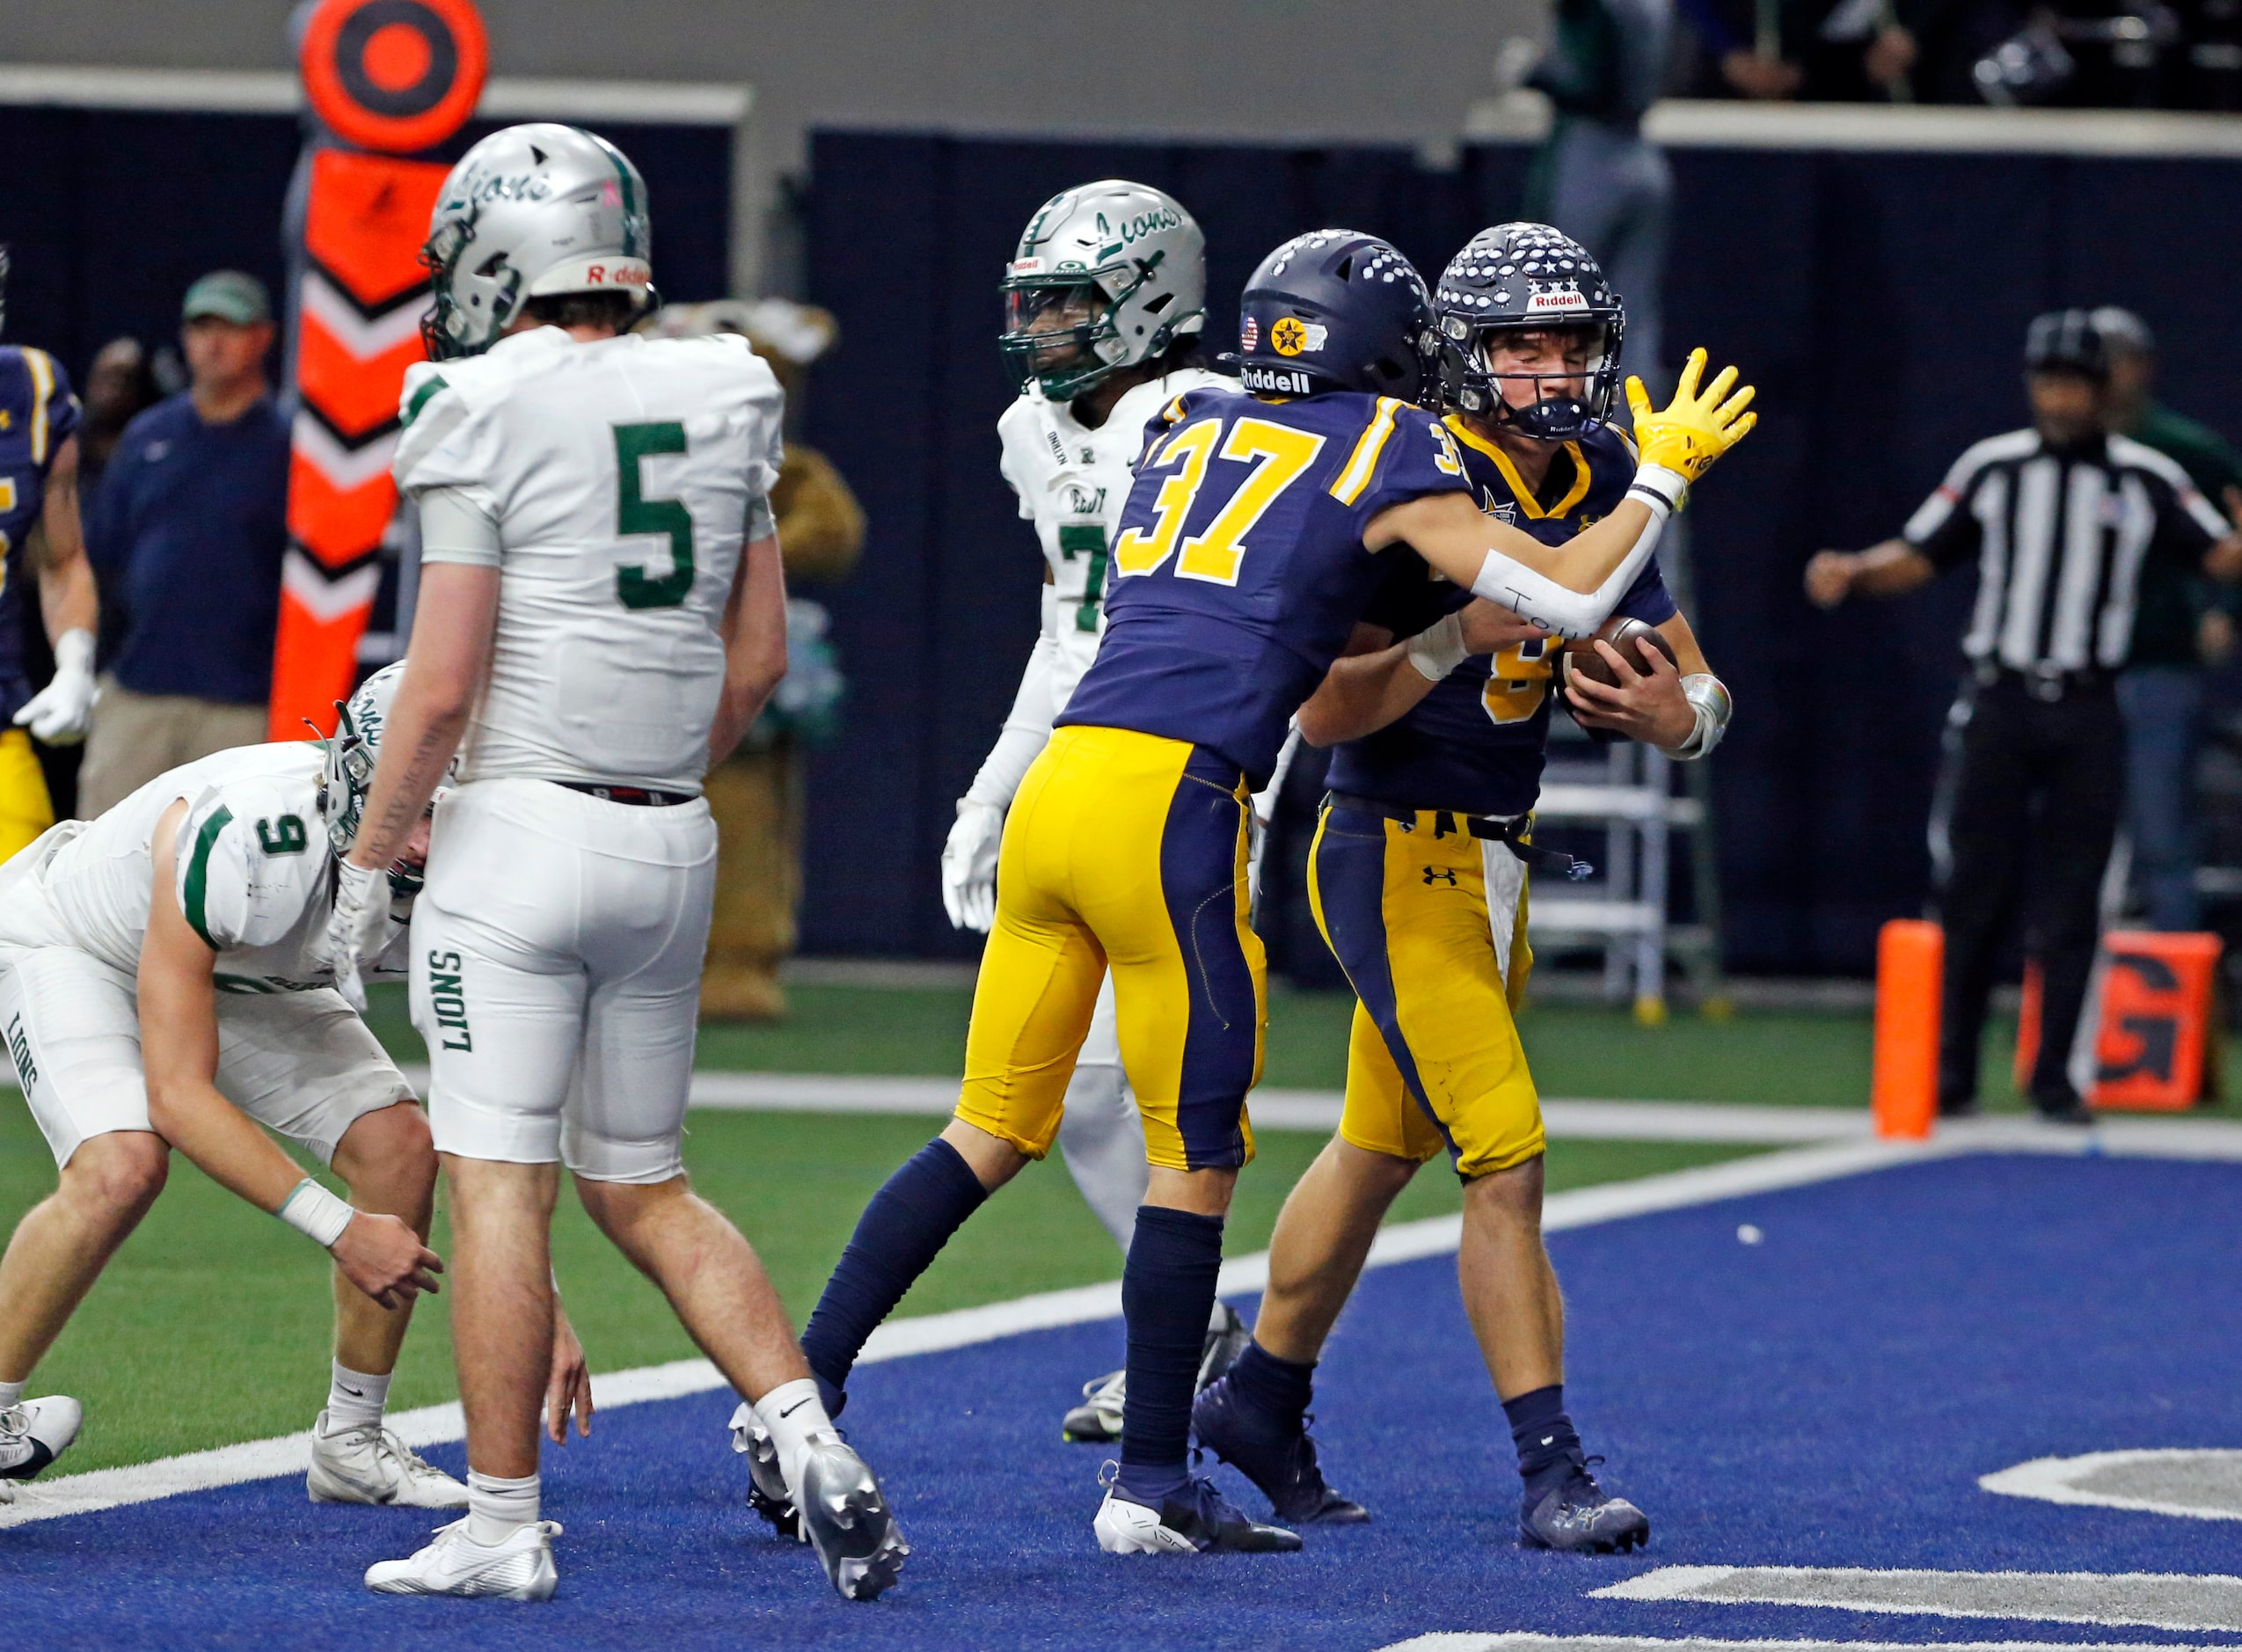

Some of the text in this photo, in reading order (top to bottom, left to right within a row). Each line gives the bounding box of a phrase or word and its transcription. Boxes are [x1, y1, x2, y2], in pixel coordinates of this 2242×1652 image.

[1534, 294, 1582, 308] Riddell
[1240, 367, 1311, 394] Riddell
[610, 418, 696, 611] 5
[1114, 415, 1328, 588] 37
[1058, 523, 1107, 633] 7
[1481, 634, 1565, 726] 8
[253, 814, 310, 859] 9
[428, 949, 472, 1053] LIONS
[7, 1011, 38, 1100] LIONS
